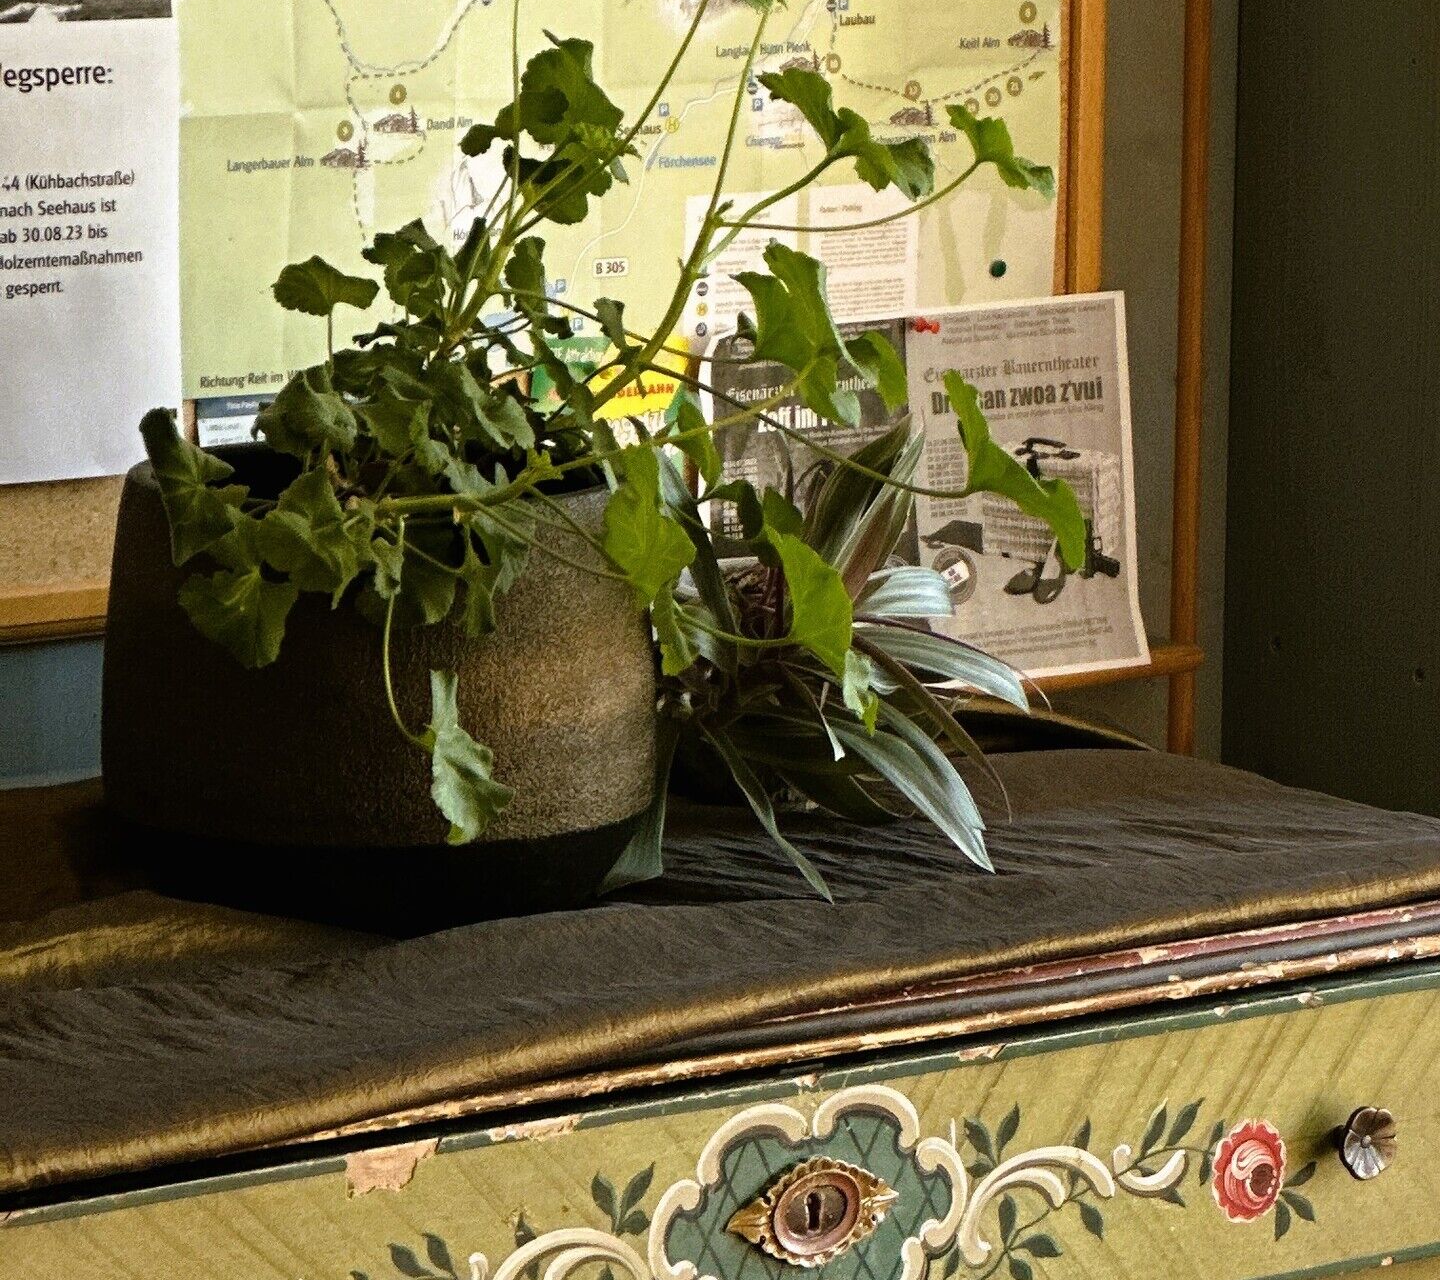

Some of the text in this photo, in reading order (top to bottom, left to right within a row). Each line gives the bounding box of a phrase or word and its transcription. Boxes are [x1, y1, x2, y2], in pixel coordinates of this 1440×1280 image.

[840, 13, 876, 26] Laubau
[0, 64, 113, 93] egsperre:
[25, 169, 134, 191] (Kühbachstraße)
[38, 199, 95, 216] Seehaus
[101, 197, 116, 213] ist
[22, 224, 82, 243] 30.08.23
[88, 223, 108, 239] bis
[606, 259, 626, 274] 305
[6, 280, 64, 299] gesperrt.
[1010, 383, 1056, 407] zwoa
